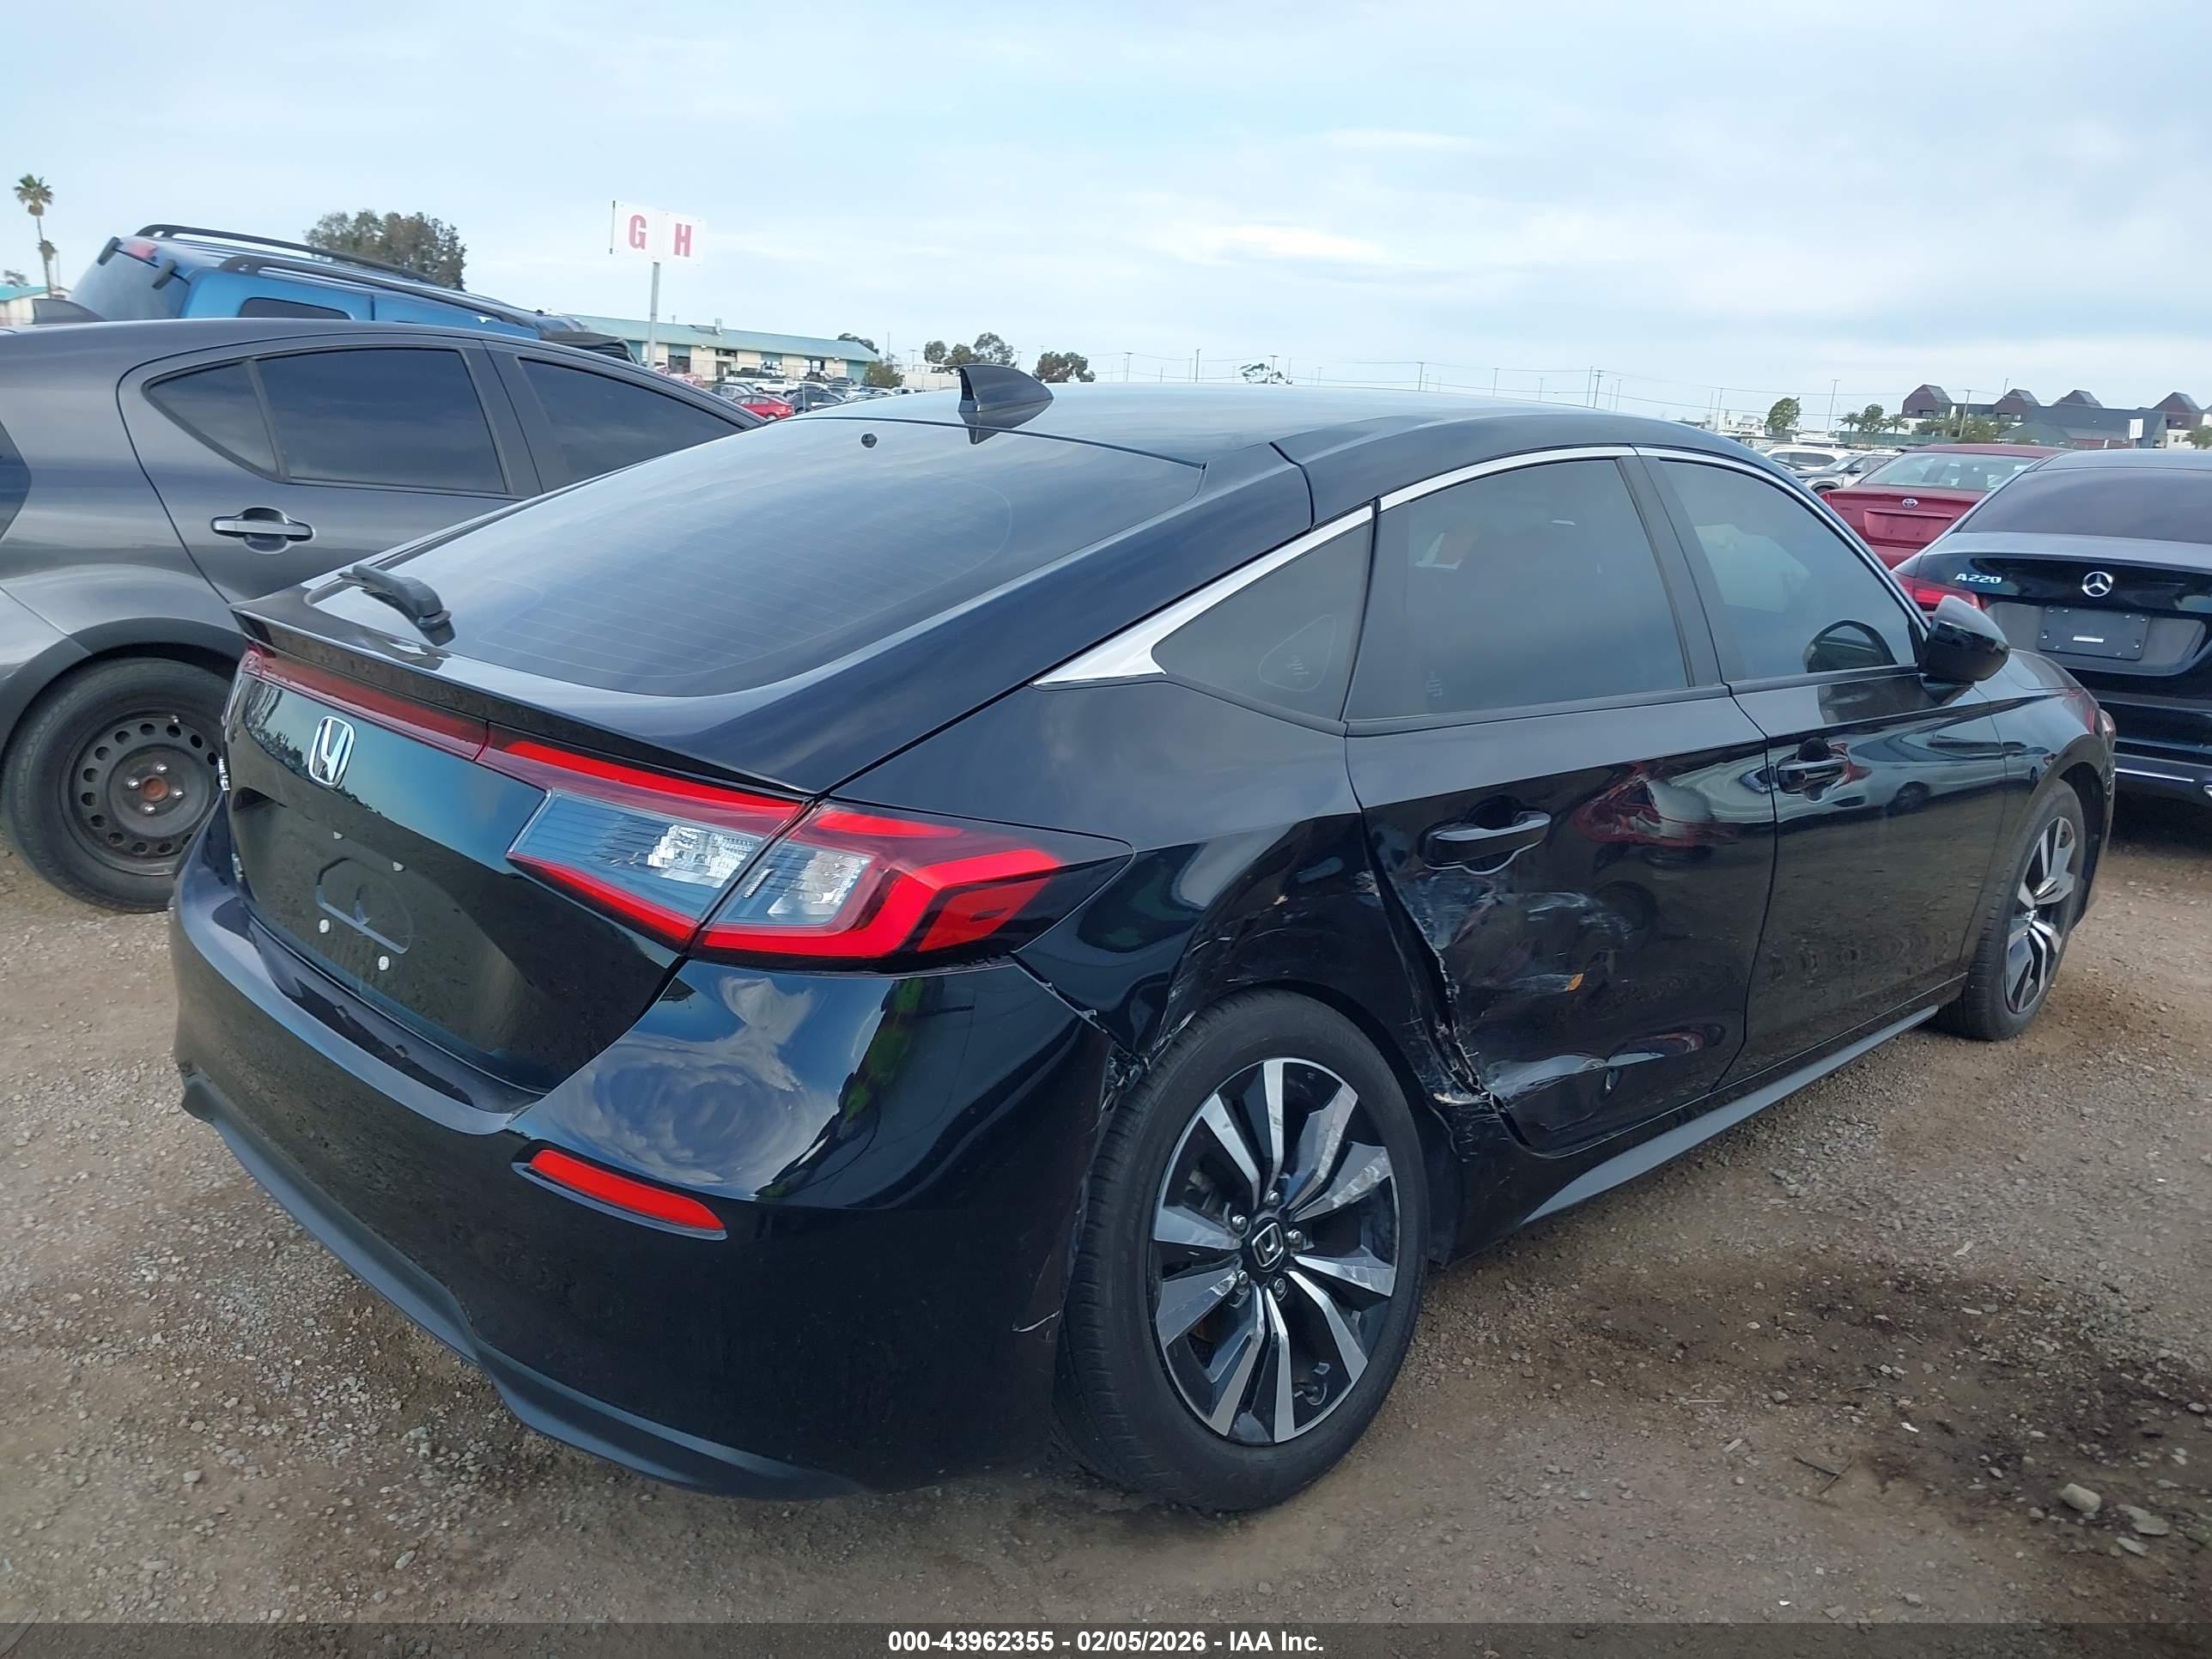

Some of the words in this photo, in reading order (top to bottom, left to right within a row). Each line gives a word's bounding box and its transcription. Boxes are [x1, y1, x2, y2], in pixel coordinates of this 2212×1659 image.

[629, 214, 647, 250] G
[674, 223, 692, 258] H
[1954, 573, 2002, 584] A220
